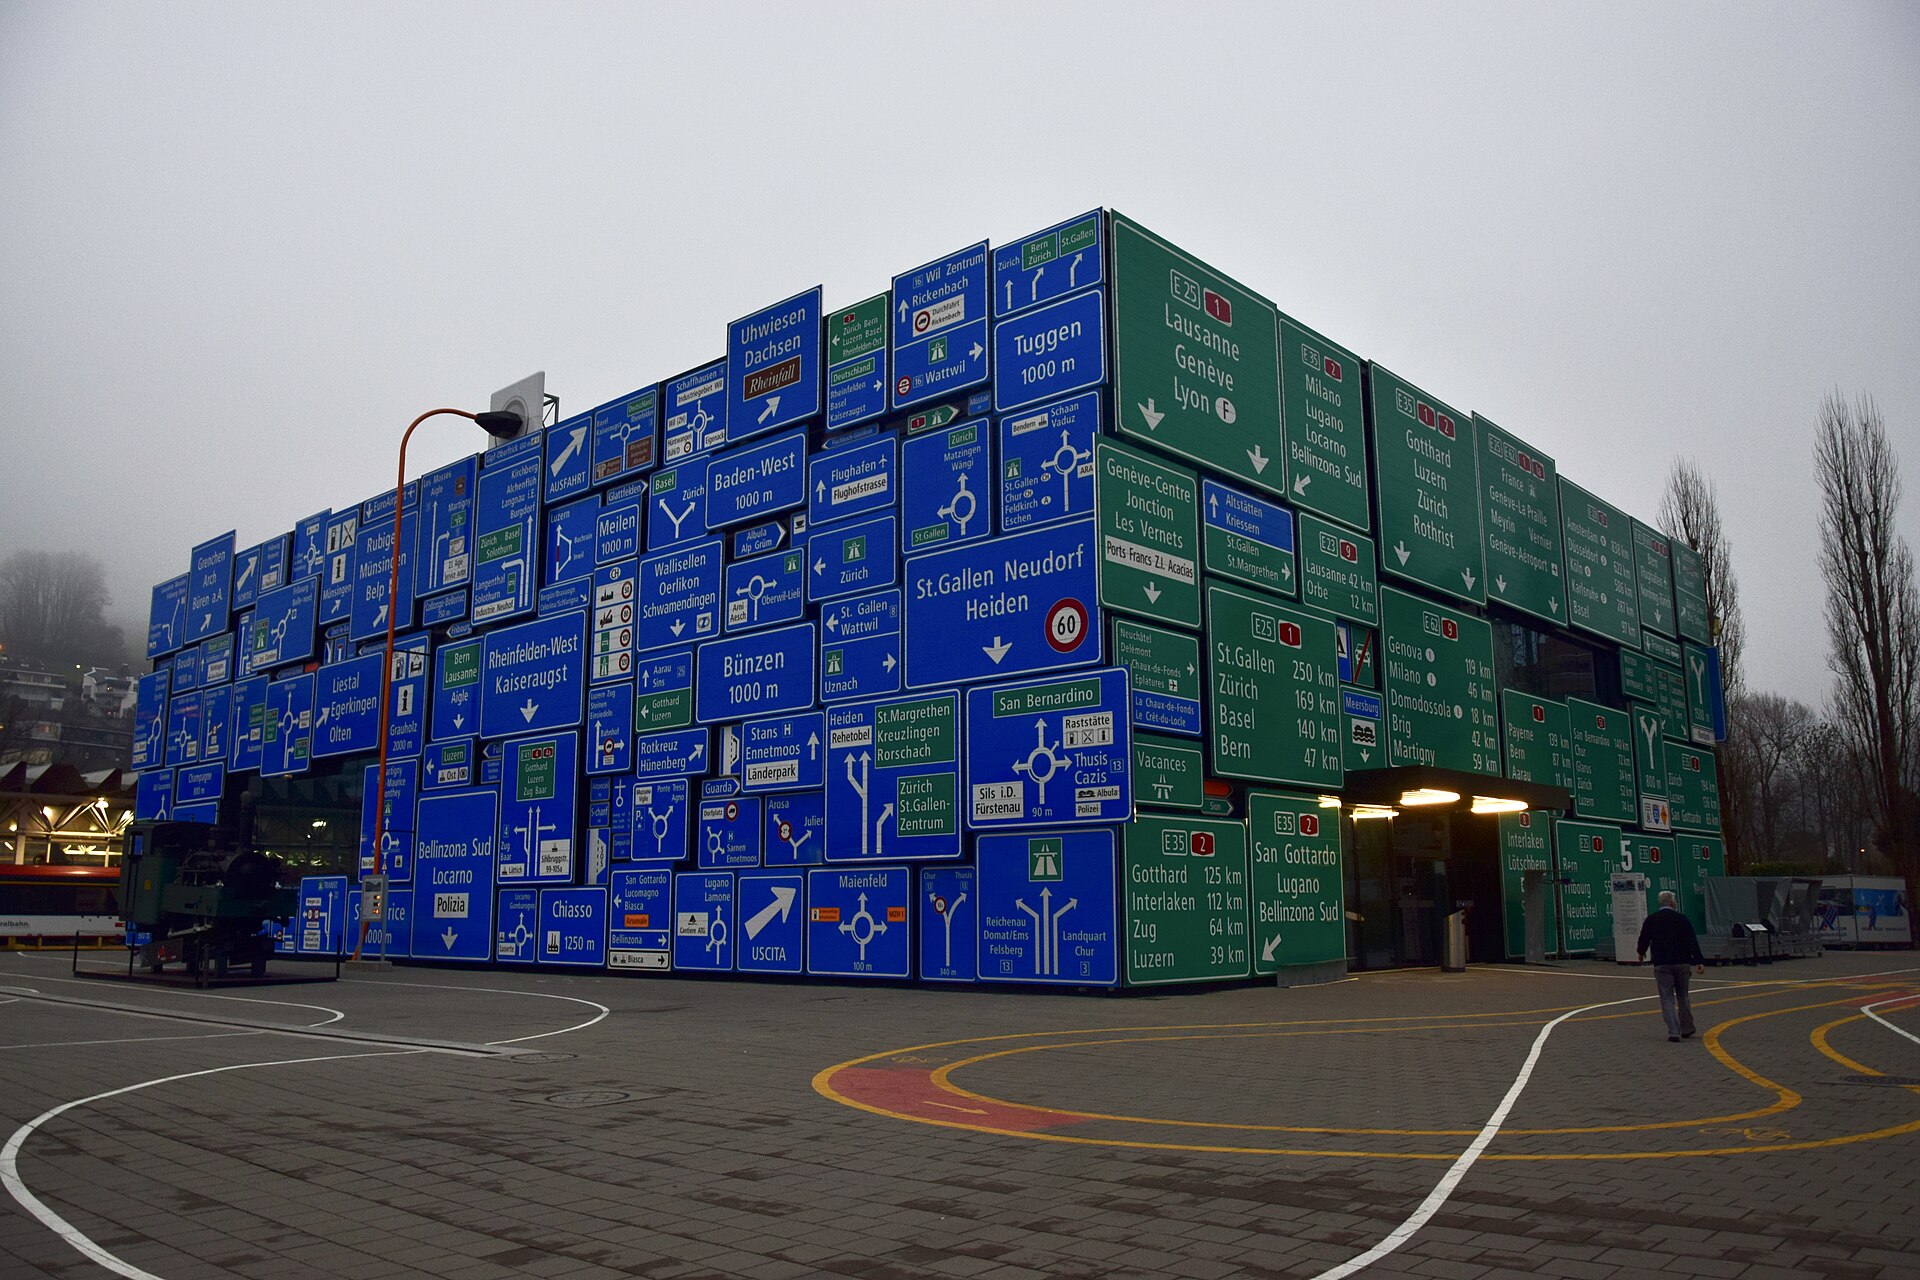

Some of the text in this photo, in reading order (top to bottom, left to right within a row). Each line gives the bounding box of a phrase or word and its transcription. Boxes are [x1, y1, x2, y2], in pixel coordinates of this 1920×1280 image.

[1030, 240, 1049, 254] Bern
[1061, 228, 1094, 248] St.Gallen
[946, 253, 984, 276] Zentrum
[998, 256, 1020, 272] Zürich
[1028, 250, 1052, 266] Zürich
[912, 276, 969, 307] Rickenbach
[741, 307, 805, 345] Uhwiesen
[1165, 302, 1240, 362] Lausanne
[1014, 319, 1081, 357] Tuggen
[745, 335, 800, 368] Dachsen
[749, 364, 794, 393] Rheinfall
[833, 362, 871, 383] Deutschland
[925, 361, 966, 384] Wattwil
[1022, 360, 1056, 385] 1000
[1175, 344, 1234, 392] Genève
[676, 370, 717, 392] Schaffhausen
[830, 380, 866, 400] Rheinfelden
[1305, 374, 1341, 407] Milano
[1174, 376, 1210, 414] Lyon
[830, 404, 866, 423] Kaiseraugst
[1306, 399, 1344, 433] Lugano
[1306, 424, 1346, 458] Locarno
[1406, 429, 1451, 468] Gotthard
[944, 445, 981, 462] Matzingen
[1292, 441, 1362, 488] Bellinzona Sud
[511, 463, 539, 480] Kirchberg
[550, 471, 586, 493] AUSFAHRT
[715, 452, 795, 491] Baden-West
[831, 460, 876, 482] Flughafen
[1107, 457, 1190, 503] Genève-Centre
[1414, 459, 1447, 491] Luzern
[1501, 467, 1524, 492] France
[608, 485, 641, 502] Glattfelden
[833, 477, 887, 502] Flughofstrasse
[1005, 476, 1038, 492] St.Gallen
[510, 502, 535, 519] Burgdorf
[735, 492, 759, 511] 1000
[1005, 498, 1038, 515] Feldkirch
[1126, 490, 1174, 521] Jonction
[1226, 494, 1263, 518] Altstätten
[1417, 489, 1448, 519] Zürich
[599, 514, 635, 538] Meilen
[1115, 512, 1183, 549] Les Vernets
[1226, 512, 1260, 535] Kriessern
[1414, 514, 1454, 549] Rothrist
[1491, 508, 1516, 533] Meyrin
[602, 540, 621, 556] 1000
[1227, 535, 1259, 557] St.Gallen
[654, 553, 706, 577] Wallisellen
[1107, 541, 1193, 579] Ports Francs Acacias
[1228, 554, 1279, 581] St.Margrethen
[1306, 557, 1346, 585] Lausanne
[203, 571, 217, 587] Arch
[840, 567, 868, 583] Zürich
[917, 543, 1084, 601] St.Gallen Neudorf
[366, 581, 384, 601] Belp
[659, 576, 699, 596] Oerlikon
[1307, 580, 1328, 599] Orbe
[643, 591, 715, 619] Schwamendingen
[858, 600, 887, 616] Gallen
[966, 593, 1028, 621] Heiden
[841, 619, 878, 636] Wattwil
[1057, 616, 1075, 636] 60
[489, 632, 578, 670] Rheinfelden-West
[1388, 635, 1423, 661] Genova
[445, 667, 477, 683] Lausanne
[724, 651, 784, 678] Bünzen
[1218, 642, 1335, 688] St.Gallen 250 km
[1389, 660, 1421, 685] Milano
[333, 671, 359, 694] Liestal
[495, 663, 567, 695] Kaiseraugst
[729, 686, 760, 704] 1000
[1000, 688, 1093, 711] San Bernardino
[1219, 673, 1336, 715] Zürich 169 km
[1391, 688, 1452, 718] Domodossola
[331, 695, 377, 719] Egerkingen
[877, 703, 950, 724] St.Margrethen
[830, 711, 863, 726] Heiden
[1220, 704, 1338, 743] Basel 140 km
[1393, 714, 1412, 738] Brig
[329, 726, 352, 743] Olten
[751, 727, 778, 741] Stans
[877, 724, 940, 744] Kreuzlingen
[1508, 723, 1534, 742] Payerne
[641, 740, 678, 755] Rotkreuz
[746, 744, 800, 760] Ennetmoos
[877, 745, 931, 761] Rorschach
[1221, 735, 1338, 771] Bern km
[1394, 738, 1435, 766] Martigny
[1510, 743, 1526, 760] Bern
[640, 757, 686, 773] Hünenberg
[1074, 751, 1107, 767] Thusis
[1137, 751, 1186, 772] Vacances
[747, 765, 796, 781] Länderpark
[1075, 769, 1107, 785] Cazis
[900, 779, 932, 795] Zürich
[769, 799, 789, 809] Arosa
[900, 817, 943, 831] Zentrum
[419, 837, 491, 859] Bellinzona Sud
[1508, 831, 1545, 850] Interlaken
[1255, 842, 1336, 866] San Gottardo
[1620, 839, 1633, 872] 5
[433, 868, 472, 885] Locarno
[1132, 864, 1242, 884] Gotthard 125 km
[1277, 872, 1320, 898] Lugano
[437, 897, 465, 914] Polizia
[552, 901, 593, 918] Chiasso
[625, 901, 644, 910] Biasca
[1132, 892, 1243, 911] Interlaken km
[1260, 901, 1338, 922] Bellinzona Sud
[1133, 917, 1244, 943] Zug km
[752, 947, 786, 961] USCITA
[1134, 945, 1245, 969] Luzern km
